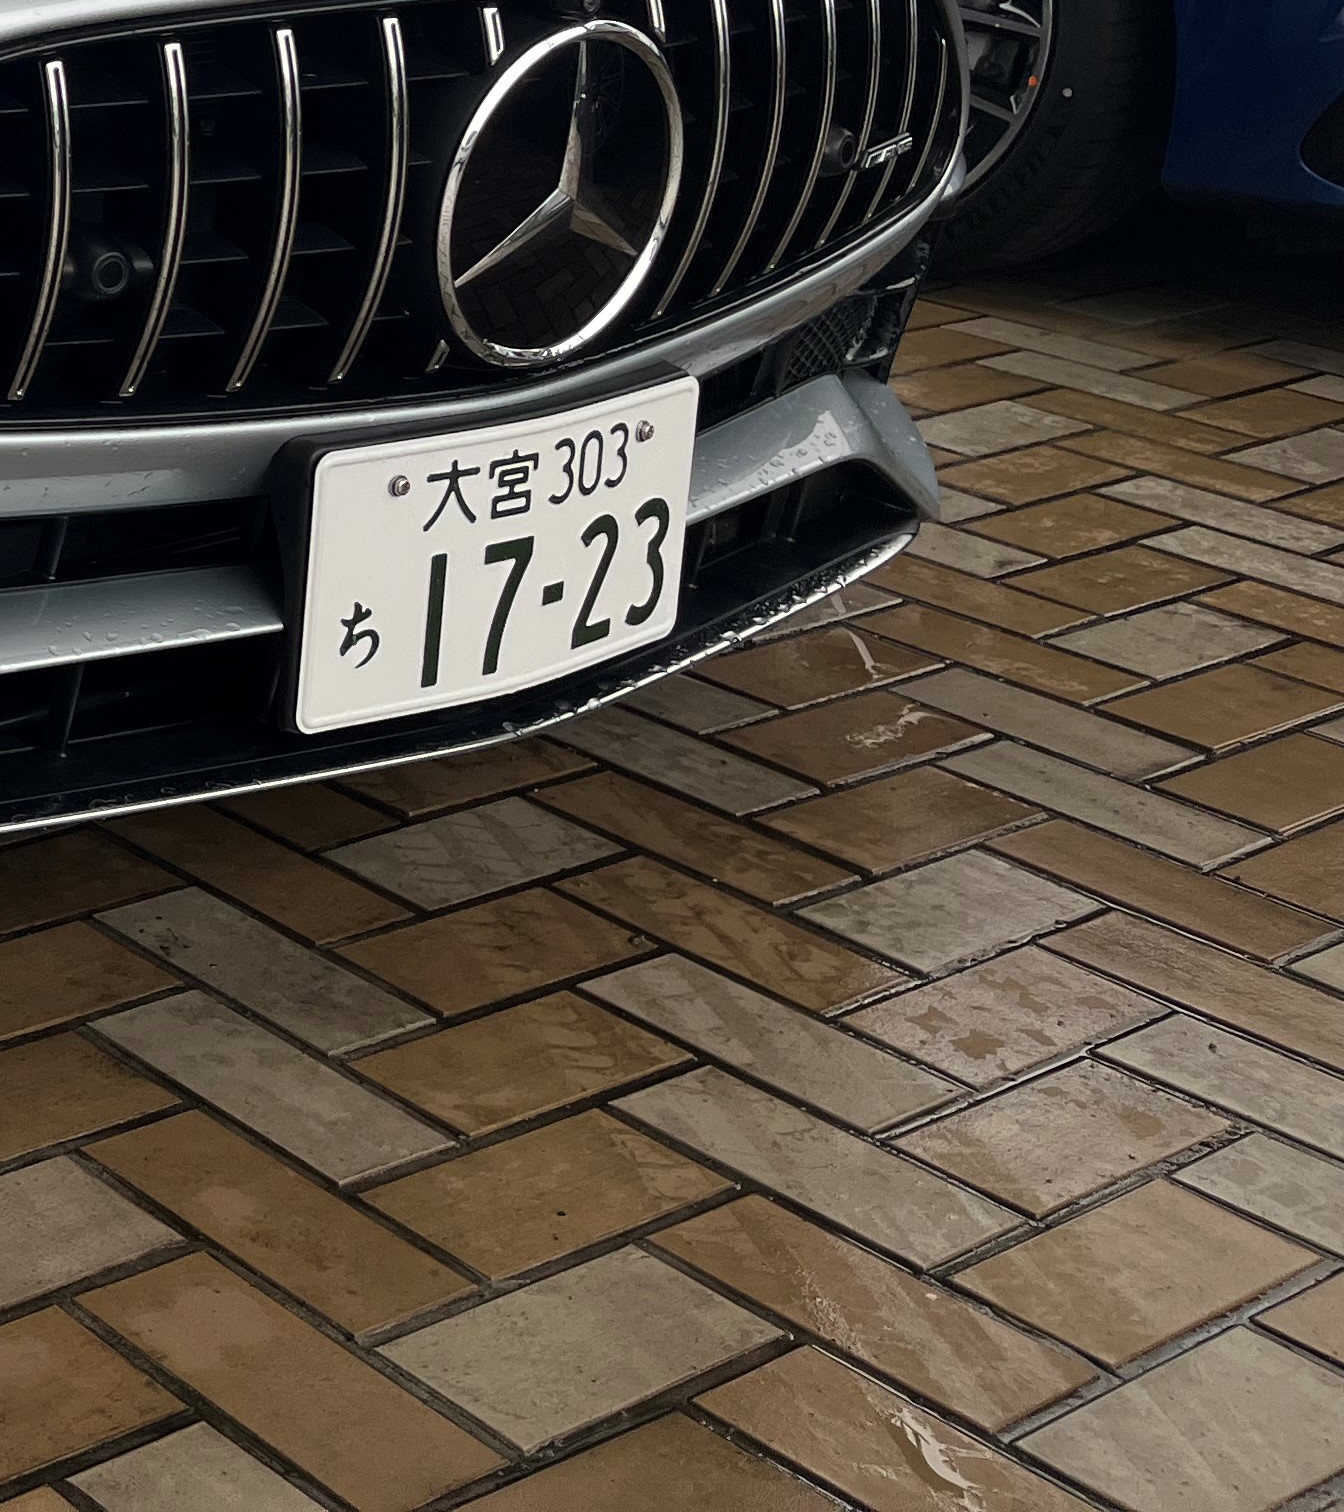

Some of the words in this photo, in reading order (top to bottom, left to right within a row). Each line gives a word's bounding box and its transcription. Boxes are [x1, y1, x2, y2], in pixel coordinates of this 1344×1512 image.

[423, 448, 539, 532] 大宮
[548, 422, 630, 505] 303
[338, 600, 381, 669] ち
[420, 497, 671, 688] 17-23
